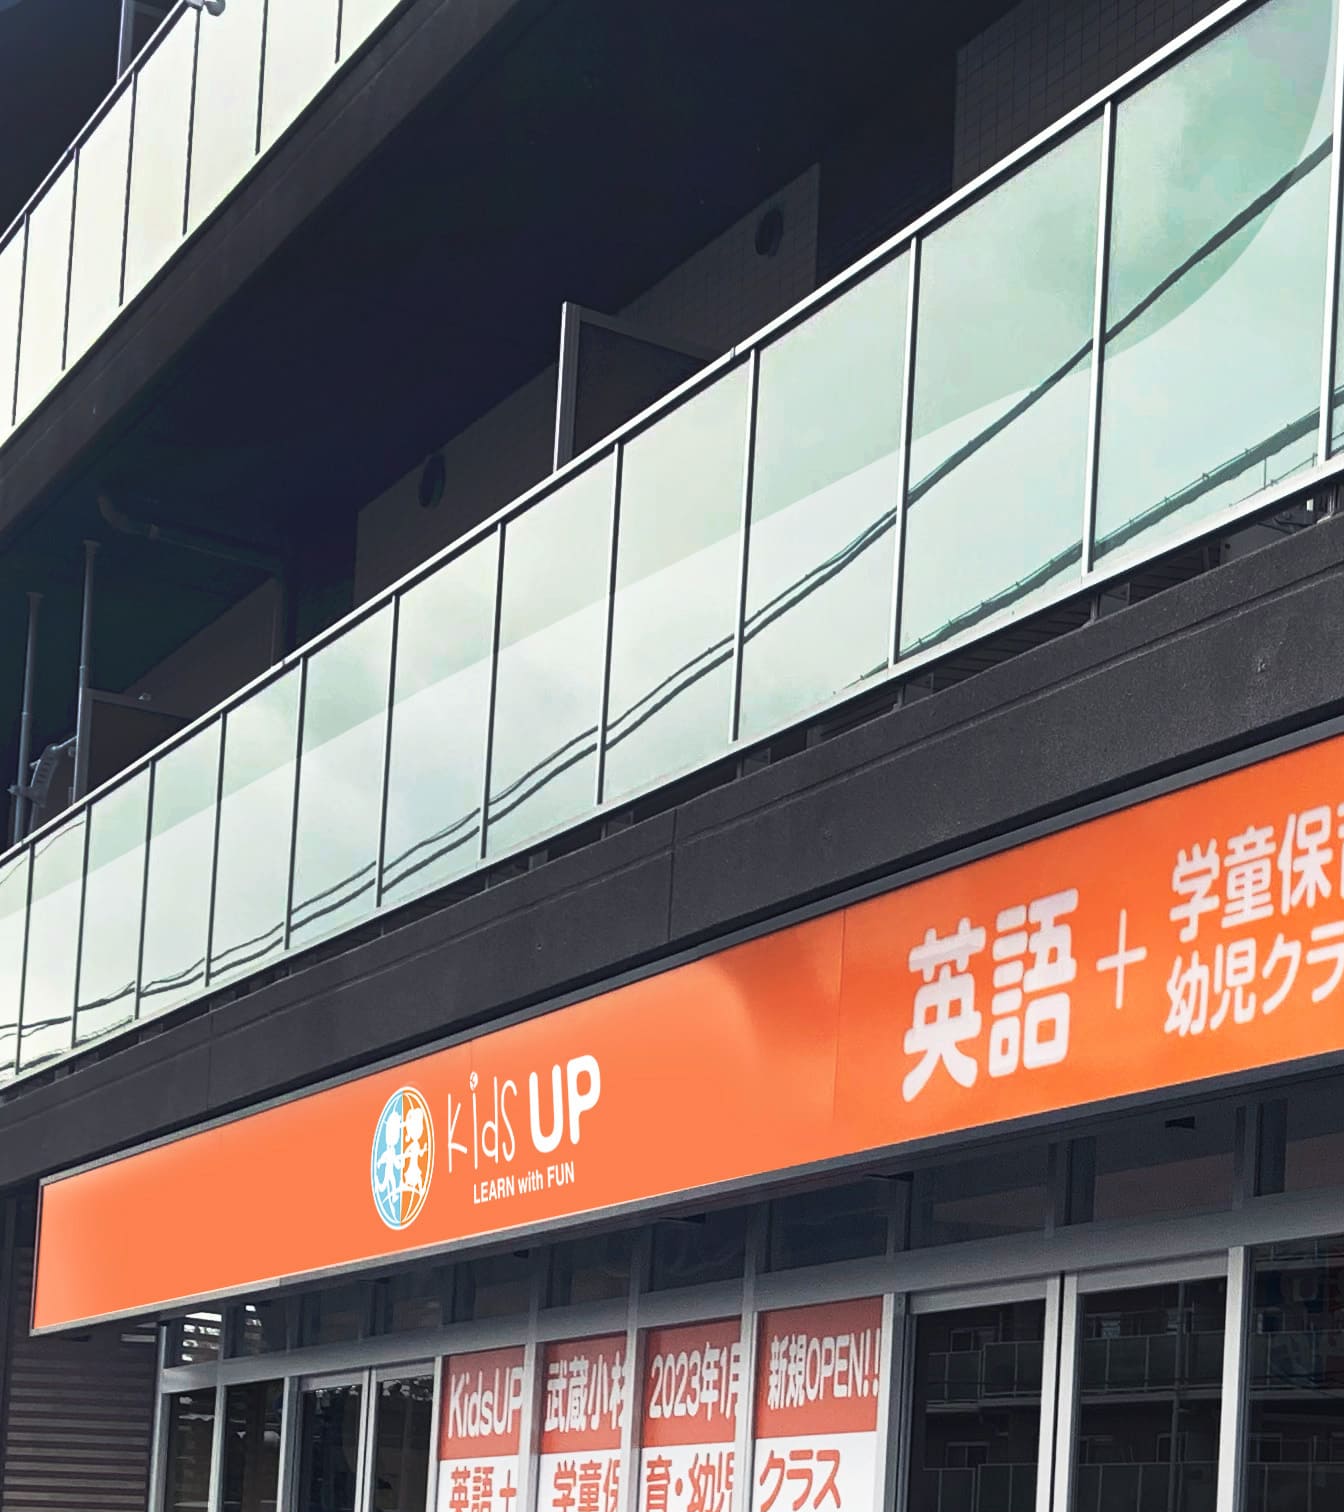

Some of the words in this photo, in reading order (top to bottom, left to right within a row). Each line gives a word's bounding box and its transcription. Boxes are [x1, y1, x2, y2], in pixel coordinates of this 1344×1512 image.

[902, 888, 1078, 1102] 英語
[529, 1055, 601, 1153] UP
[473, 1175, 515, 1204] LEARN
[518, 1172, 543, 1194] with
[547, 1161, 575, 1187] FUN
[448, 1366, 523, 1439] KidsUP
